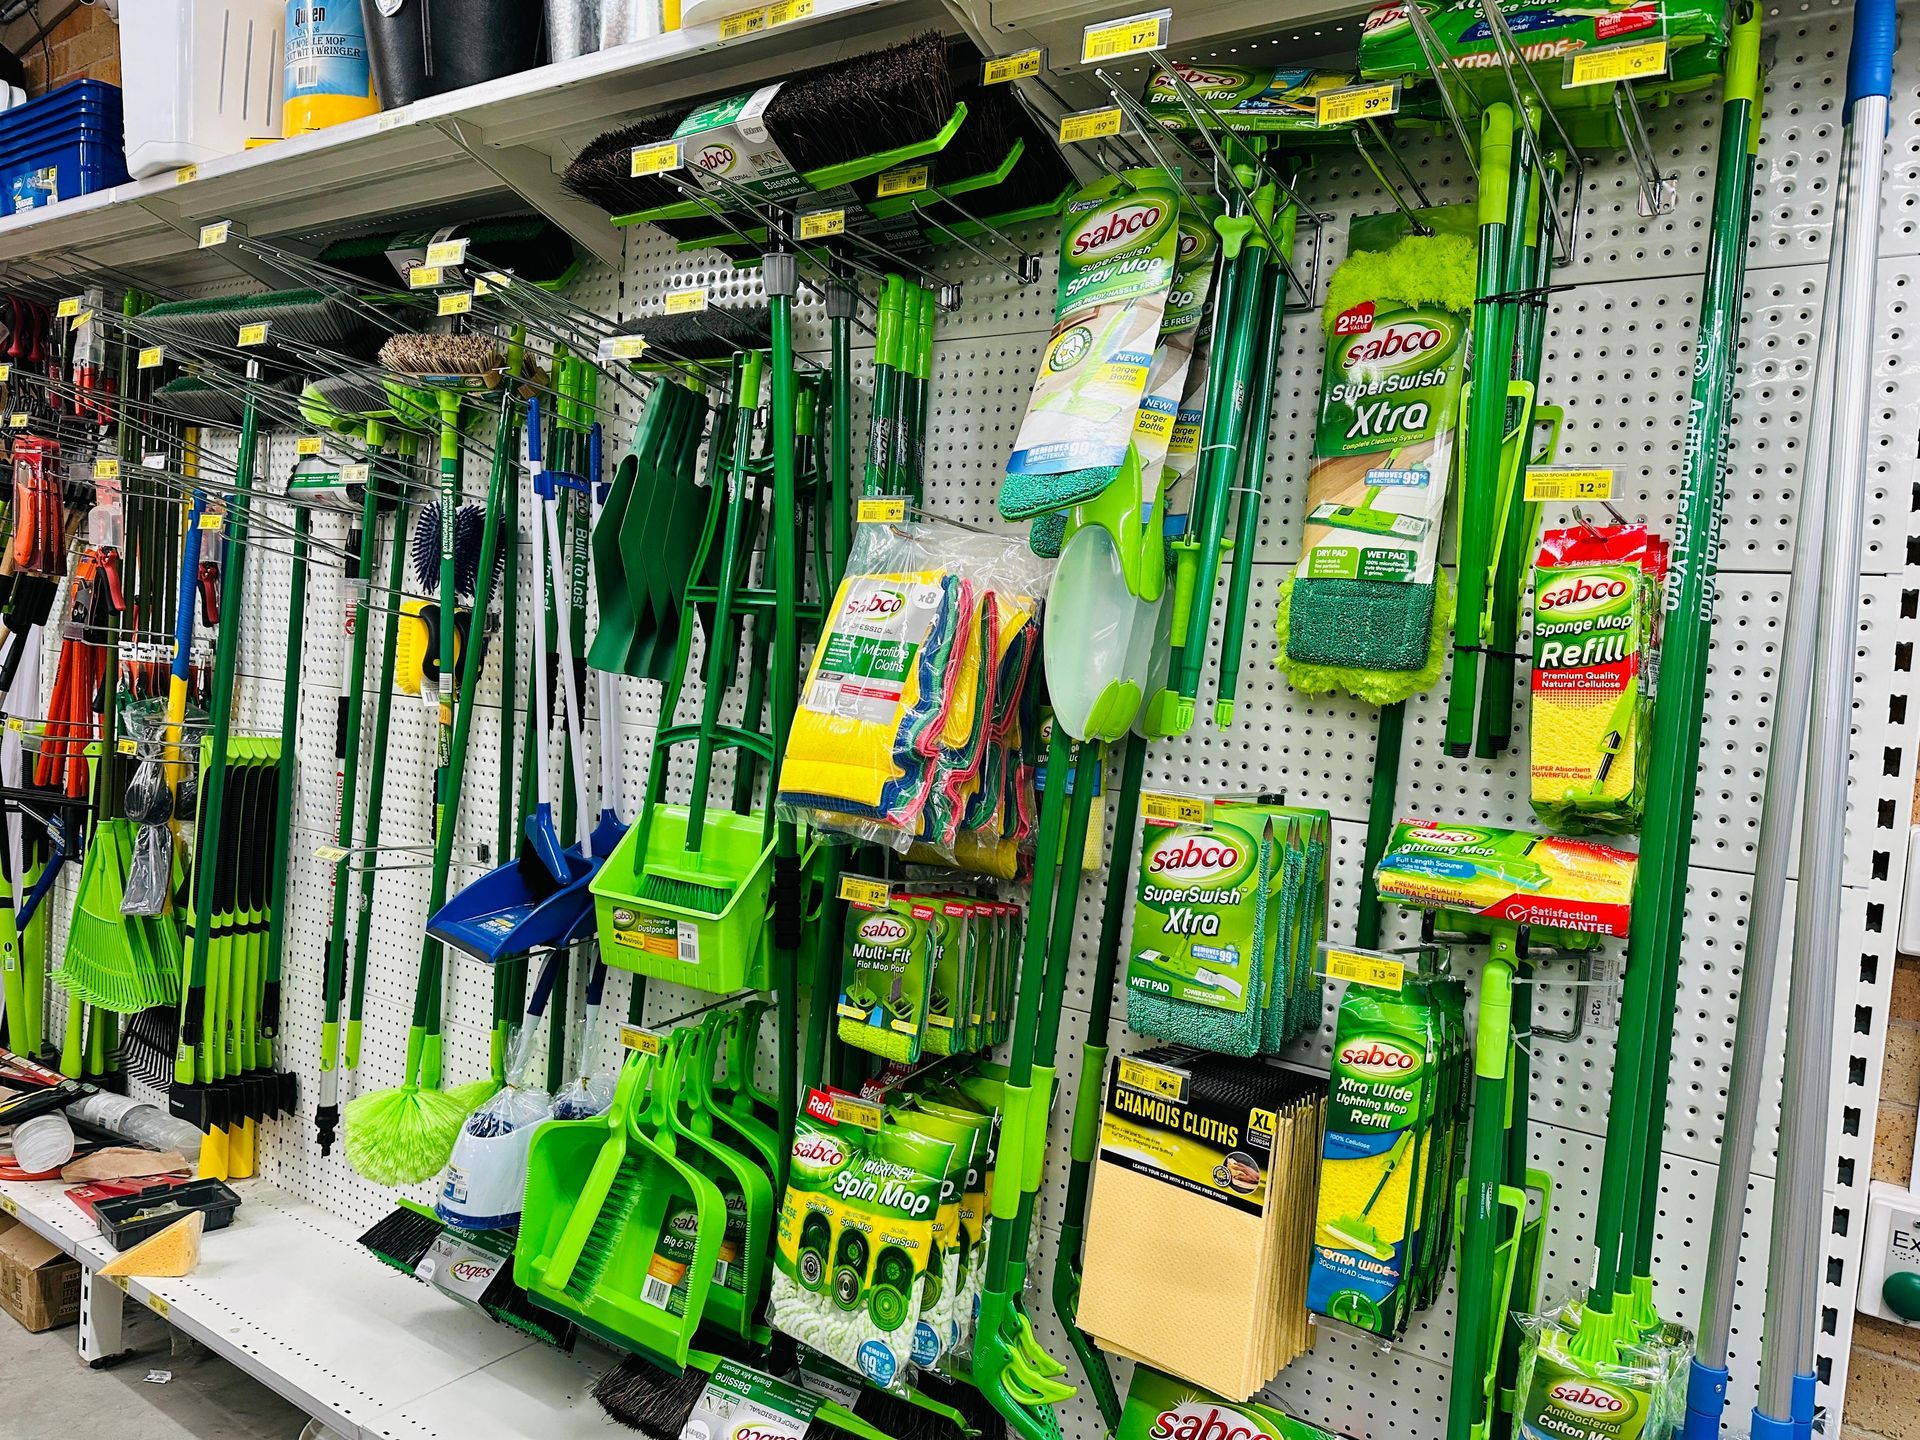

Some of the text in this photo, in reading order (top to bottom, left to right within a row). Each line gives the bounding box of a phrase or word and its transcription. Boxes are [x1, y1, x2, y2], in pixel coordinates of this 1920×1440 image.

[325, 36, 346, 46] MOP
[1132, 31, 1155, 44] 17.95
[316, 46, 361, 57] WRINGER
[1630, 56, 1655, 68] $6.50
[1205, 90, 1238, 101] Mop
[1365, 97, 1389, 109] 39.95
[762, 175, 800, 191] Bassine
[789, 185, 808, 196] Broom
[884, 227, 920, 242] Bassine
[1072, 207, 1160, 256] sabco
[1080, 244, 1151, 275] SuperSwish
[1065, 256, 1164, 298] Spray Mop
[1171, 314, 1193, 326] FREE!
[1337, 313, 1373, 332] 2 PAD
[1343, 328, 1442, 369] sabco
[1116, 353, 1146, 364] NEW!
[1331, 370, 1446, 402] SuperSwish
[1145, 399, 1173, 411] NEW!
[1138, 421, 1164, 432] Bottle
[1140, 411, 1167, 424] Larger
[1347, 402, 1429, 438] Xtra
[1342, 431, 1424, 451] Complete Cleaning System
[1579, 483, 1606, 493] 12.50
[572, 527, 588, 610] Built to Last
[846, 592, 937, 616] sabco x8
[1538, 577, 1626, 612] sabco
[1535, 614, 1632, 637] Sponge Mop
[1540, 635, 1623, 669] Refill
[874, 659, 905, 673] Cloths
[1542, 671, 1620, 682] Premium Quality
[1542, 680, 1620, 689] Natural Cellulose
[1410, 829, 1477, 843] sabco
[1149, 840, 1238, 873] sabco
[1461, 845, 1496, 857] Mop
[1408, 858, 1433, 868] Length
[1434, 860, 1464, 870] Scourer
[1143, 885, 1241, 905] SuperSwish
[1381, 884, 1476, 908] NATURAL CELLULOSE
[1394, 879, 1464, 898] PREMIUM QUALITY
[1163, 907, 1221, 936] Xtra
[1530, 905, 1599, 922] Satisfaction
[637, 924, 676, 936] Dustpan Set
[859, 922, 906, 939] sabco
[1529, 916, 1614, 934] GUARANTEE
[852, 943, 911, 963] Multi-Fit
[873, 962, 889, 972] Mop
[890, 964, 905, 973] Pad
[1131, 976, 1170, 993] WET PAD
[1338, 1046, 1415, 1070] sabco
[1338, 1076, 1414, 1102] Xtra Wide
[1336, 1092, 1408, 1115] Lightning Mop
[1114, 1089, 1180, 1129] CHAMOIS
[1183, 1110, 1239, 1149] CLOTHS
[1252, 1111, 1272, 1132] XL
[1350, 1109, 1392, 1129] Refill
[1330, 1133, 1344, 1143] 100%
[1346, 1137, 1371, 1149] Cellulose
[791, 1139, 843, 1166] sabco
[1132, 1162, 1148, 1173] LEAVES
[1160, 1171, 1169, 1180] CAR
[1202, 1186, 1213, 1196] FREE
[834, 1170, 930, 1216] Spin Mop
[821, 1205, 834, 1216] Mop
[840, 1217, 873, 1233] Spin Mop
[663, 1234, 676, 1248] Big
[879, 1232, 920, 1249] CleanSpin
[454, 1262, 495, 1280] sabco
[1318, 1257, 1336, 1272] 30cm
[1336, 1265, 1357, 1278] HEAD
[1323, 1248, 1392, 1277] EXTRA WIDE
[864, 1344, 890, 1361] REMOVES
[715, 1372, 752, 1395] Bassine
[741, 1369, 752, 1381] Mix
[752, 1374, 773, 1389] Bristle
[802, 1373, 851, 1399] PROFESSIONAL
[1550, 1385, 1622, 1413] sabco
[749, 1403, 801, 1431] PROFESSIONAL
[1537, 1414, 1584, 1439] Cotton
[1543, 1404, 1621, 1435] Antibacterial
